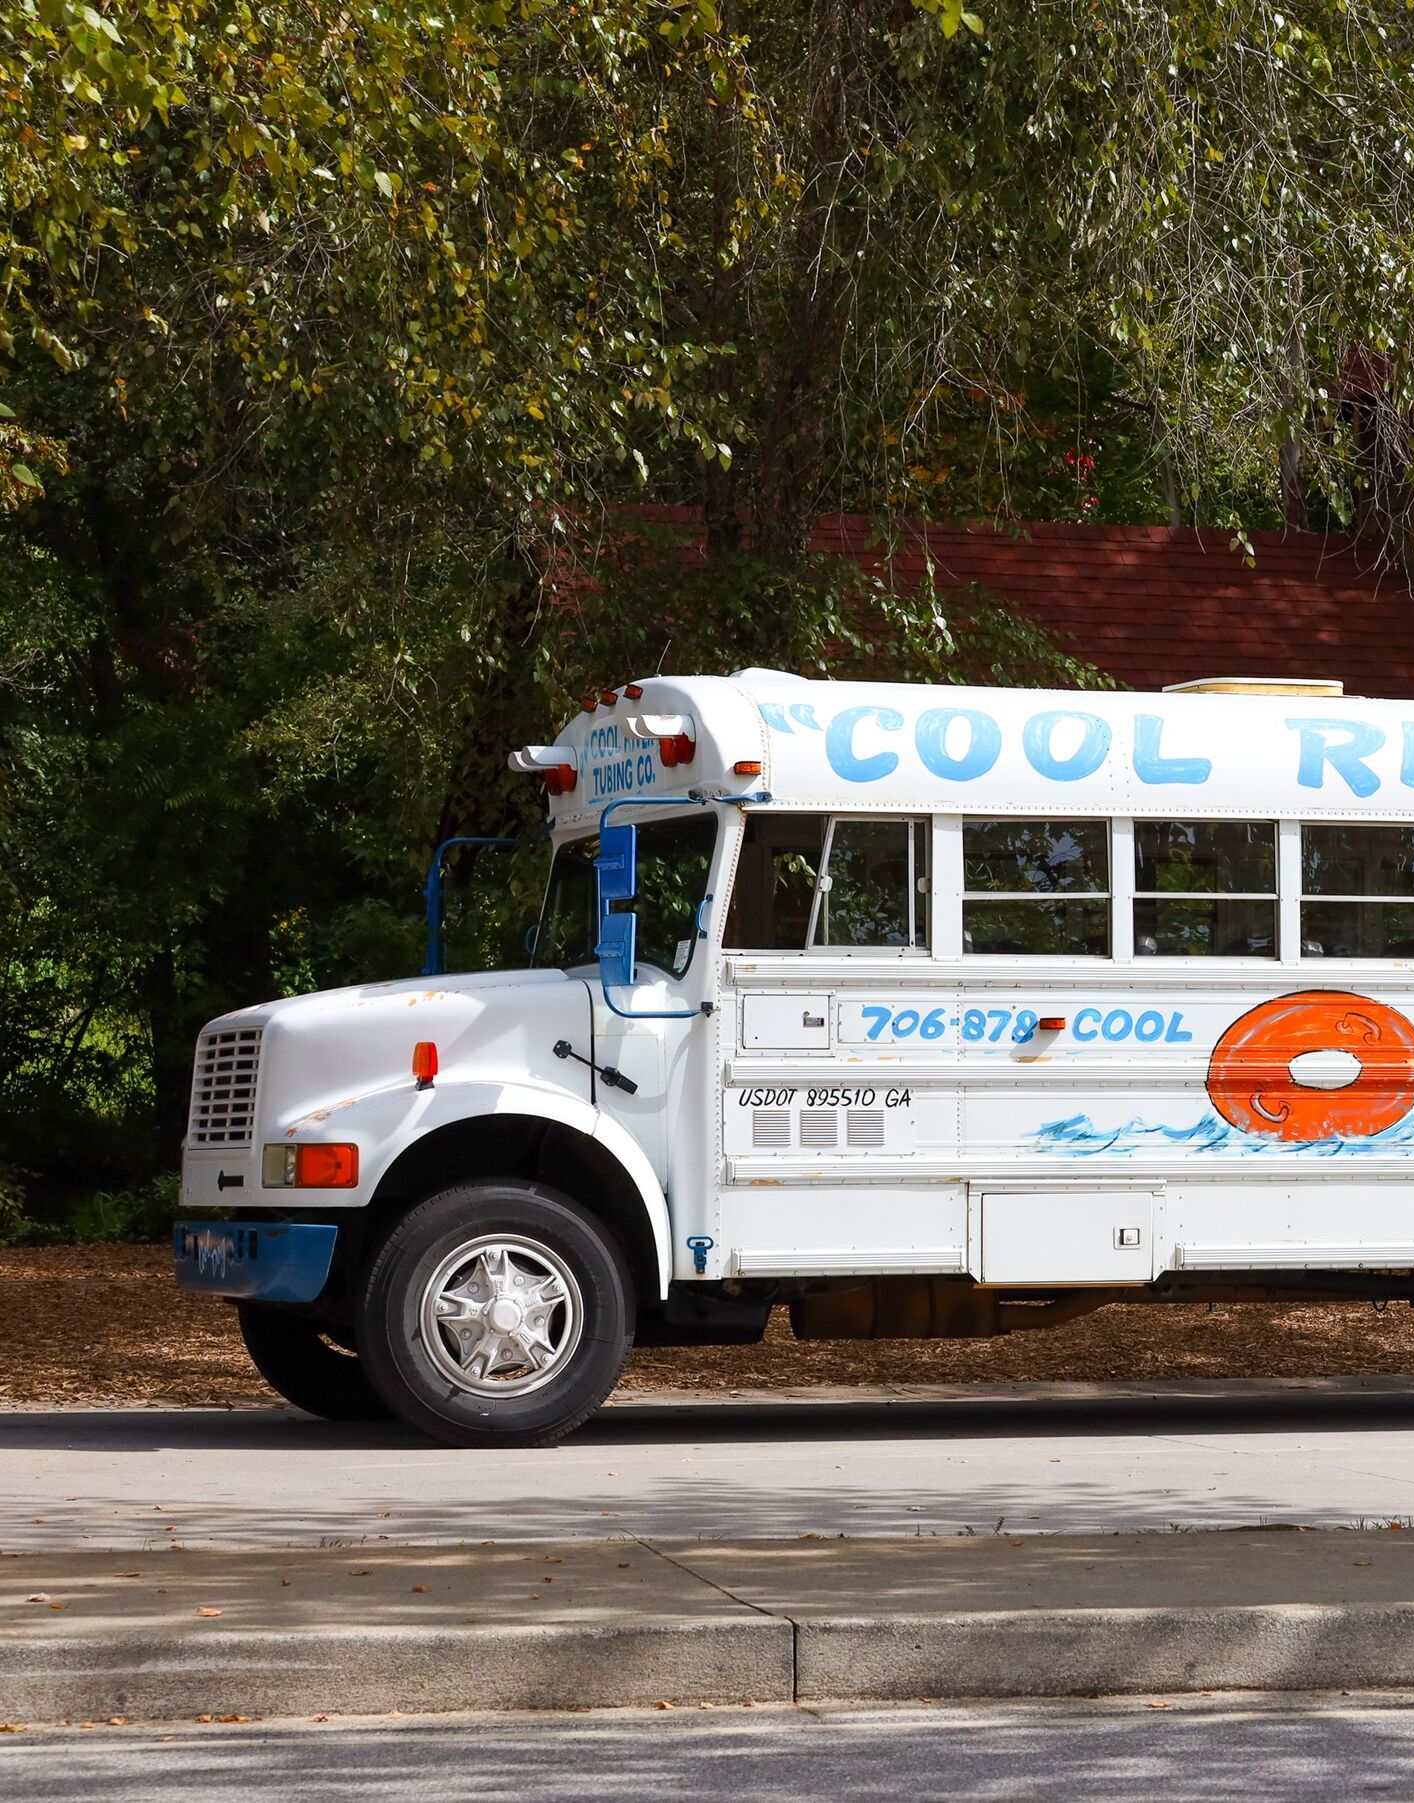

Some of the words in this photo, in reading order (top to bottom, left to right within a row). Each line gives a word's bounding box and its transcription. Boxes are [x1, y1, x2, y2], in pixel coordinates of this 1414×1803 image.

[590, 725, 621, 759] COOL
[592, 758, 633, 796] TUBING
[637, 754, 656, 787] CO.
[1072, 1008, 1193, 1043] COOL
[738, 1088, 799, 1107] USDOT
[806, 1088, 876, 1107] 895510
[884, 1088, 912, 1108] GA
